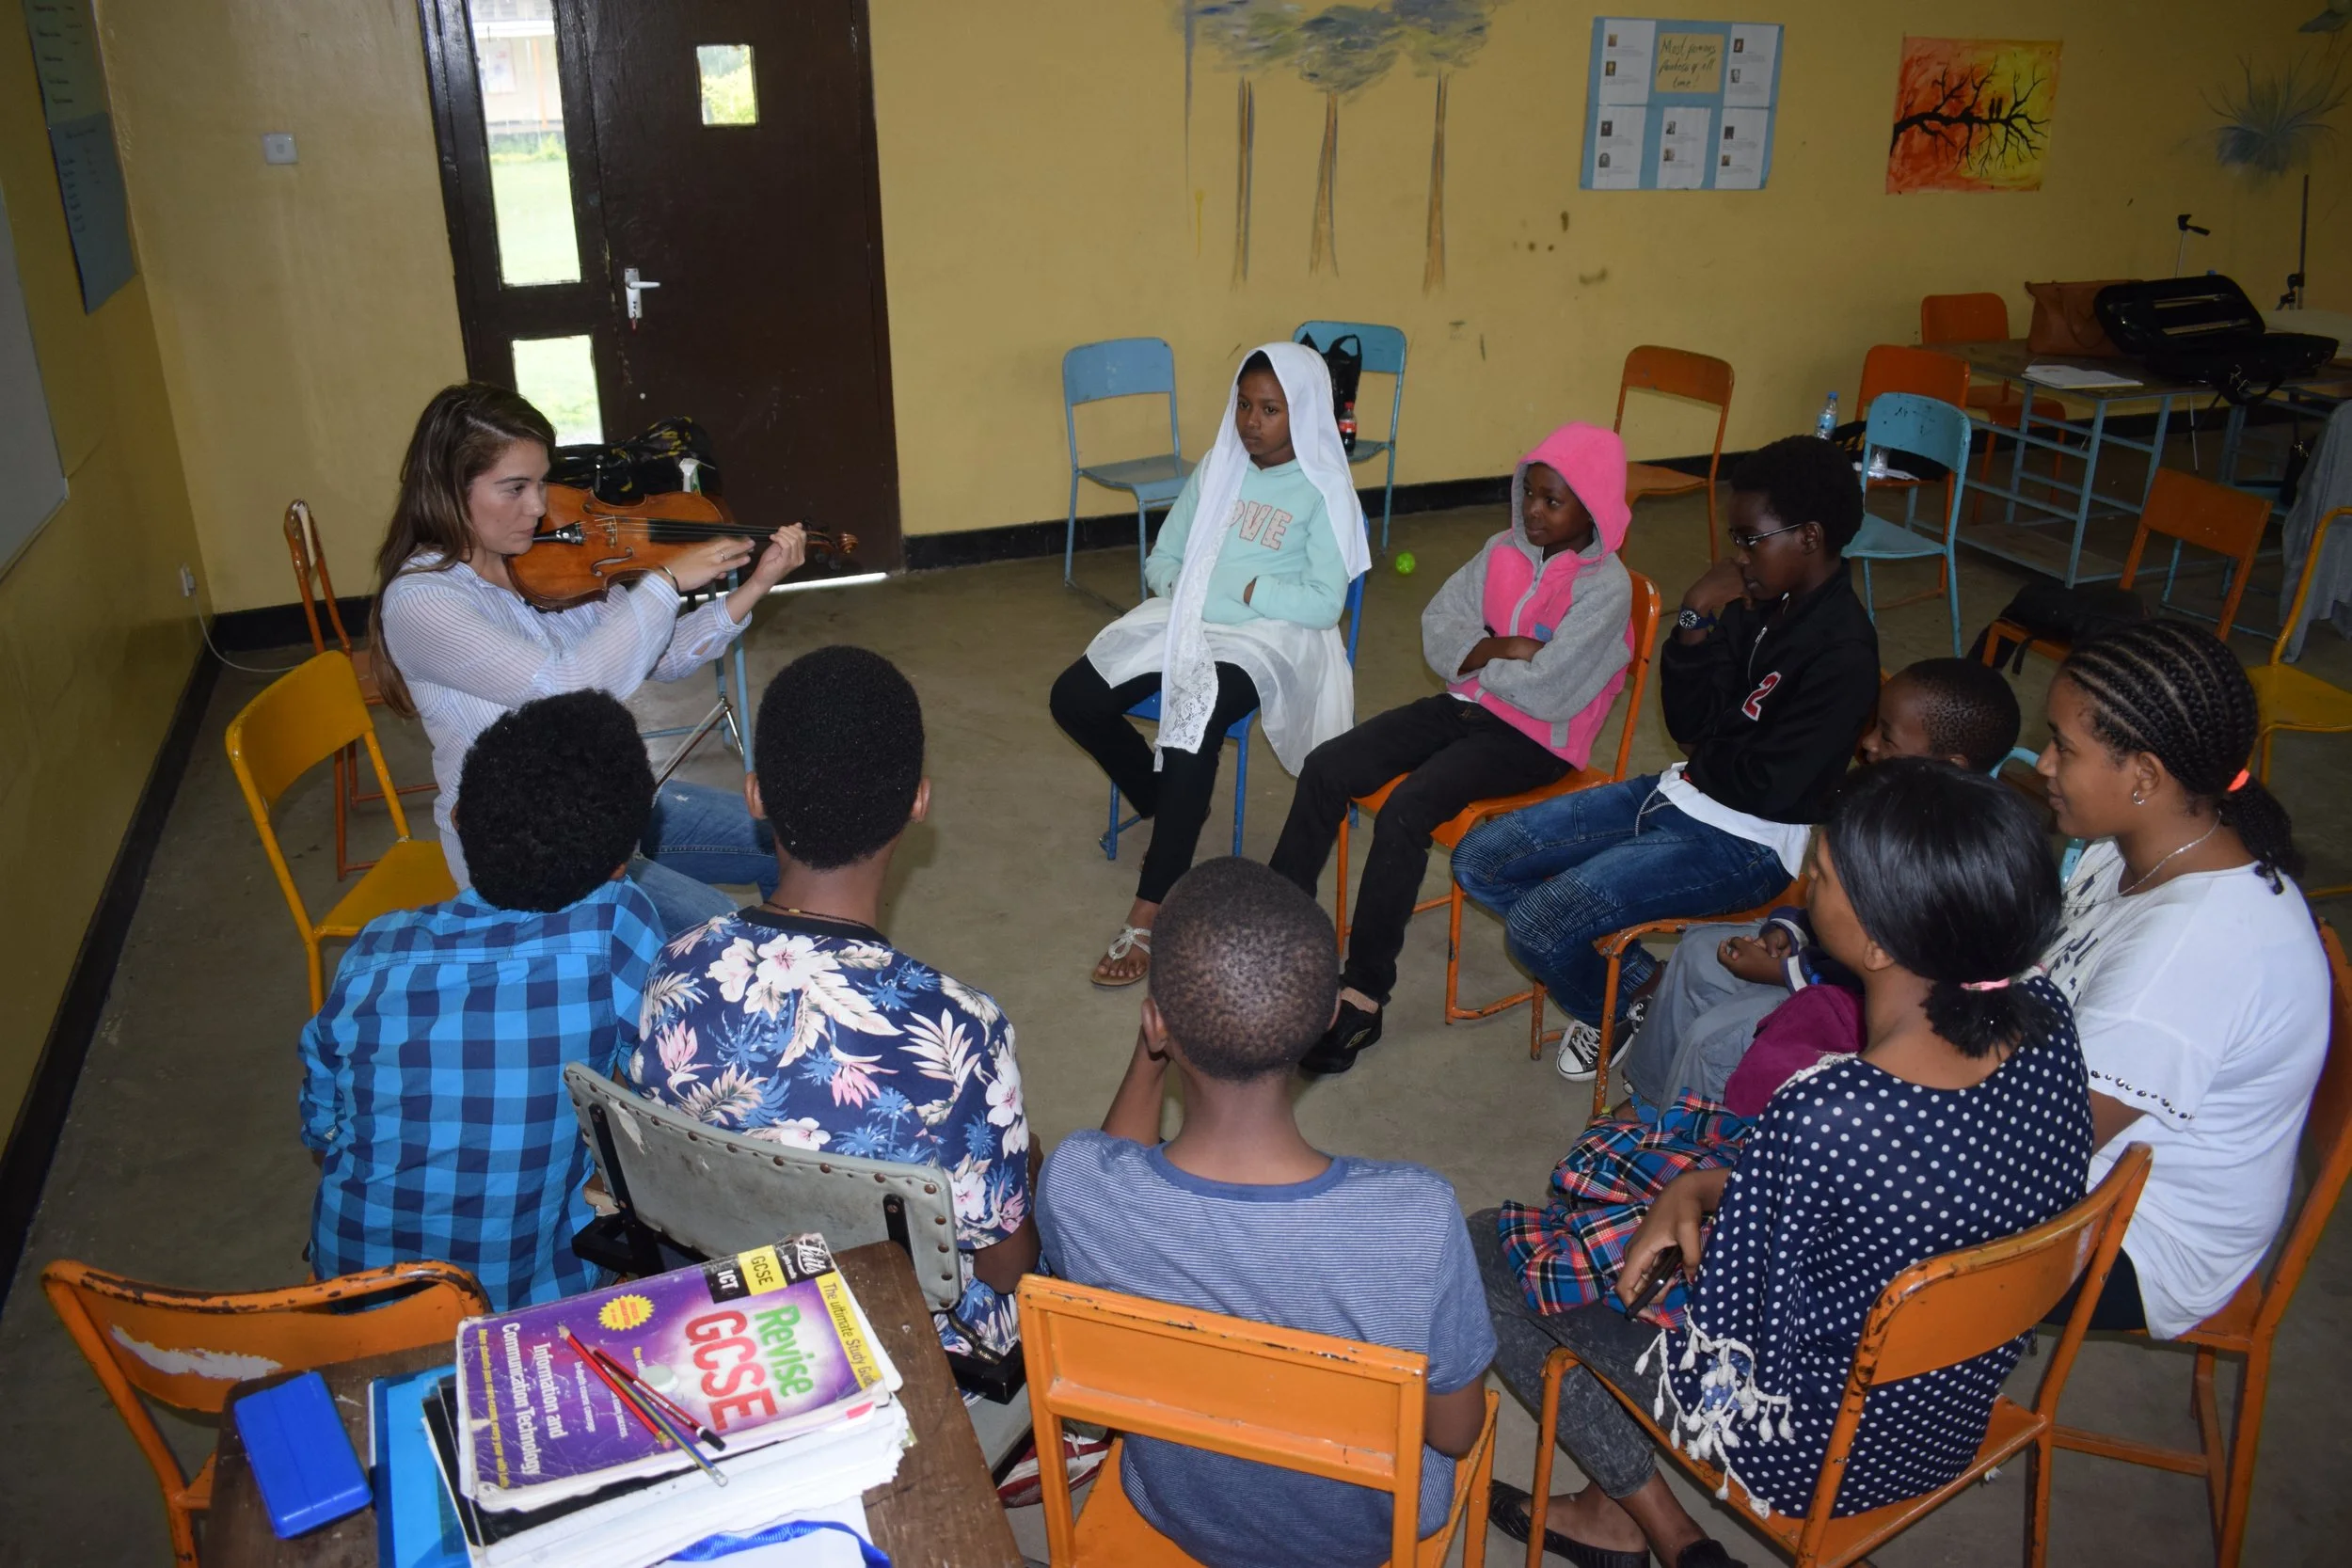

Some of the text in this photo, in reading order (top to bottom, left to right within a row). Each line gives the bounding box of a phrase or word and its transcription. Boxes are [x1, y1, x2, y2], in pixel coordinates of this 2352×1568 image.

[1741, 671, 1782, 721] 2
[717, 1270, 739, 1291] ICT
[751, 1256, 773, 1286] GCSE
[755, 1304, 814, 1399] Revise
[823, 1283, 837, 1300] The
[830, 1301, 854, 1338] ultimate
[845, 1338, 866, 1364] Study
[502, 1323, 541, 1476] Communication Technology
[533, 1343, 567, 1438] Information and
[684, 1309, 778, 1432] GCSE
